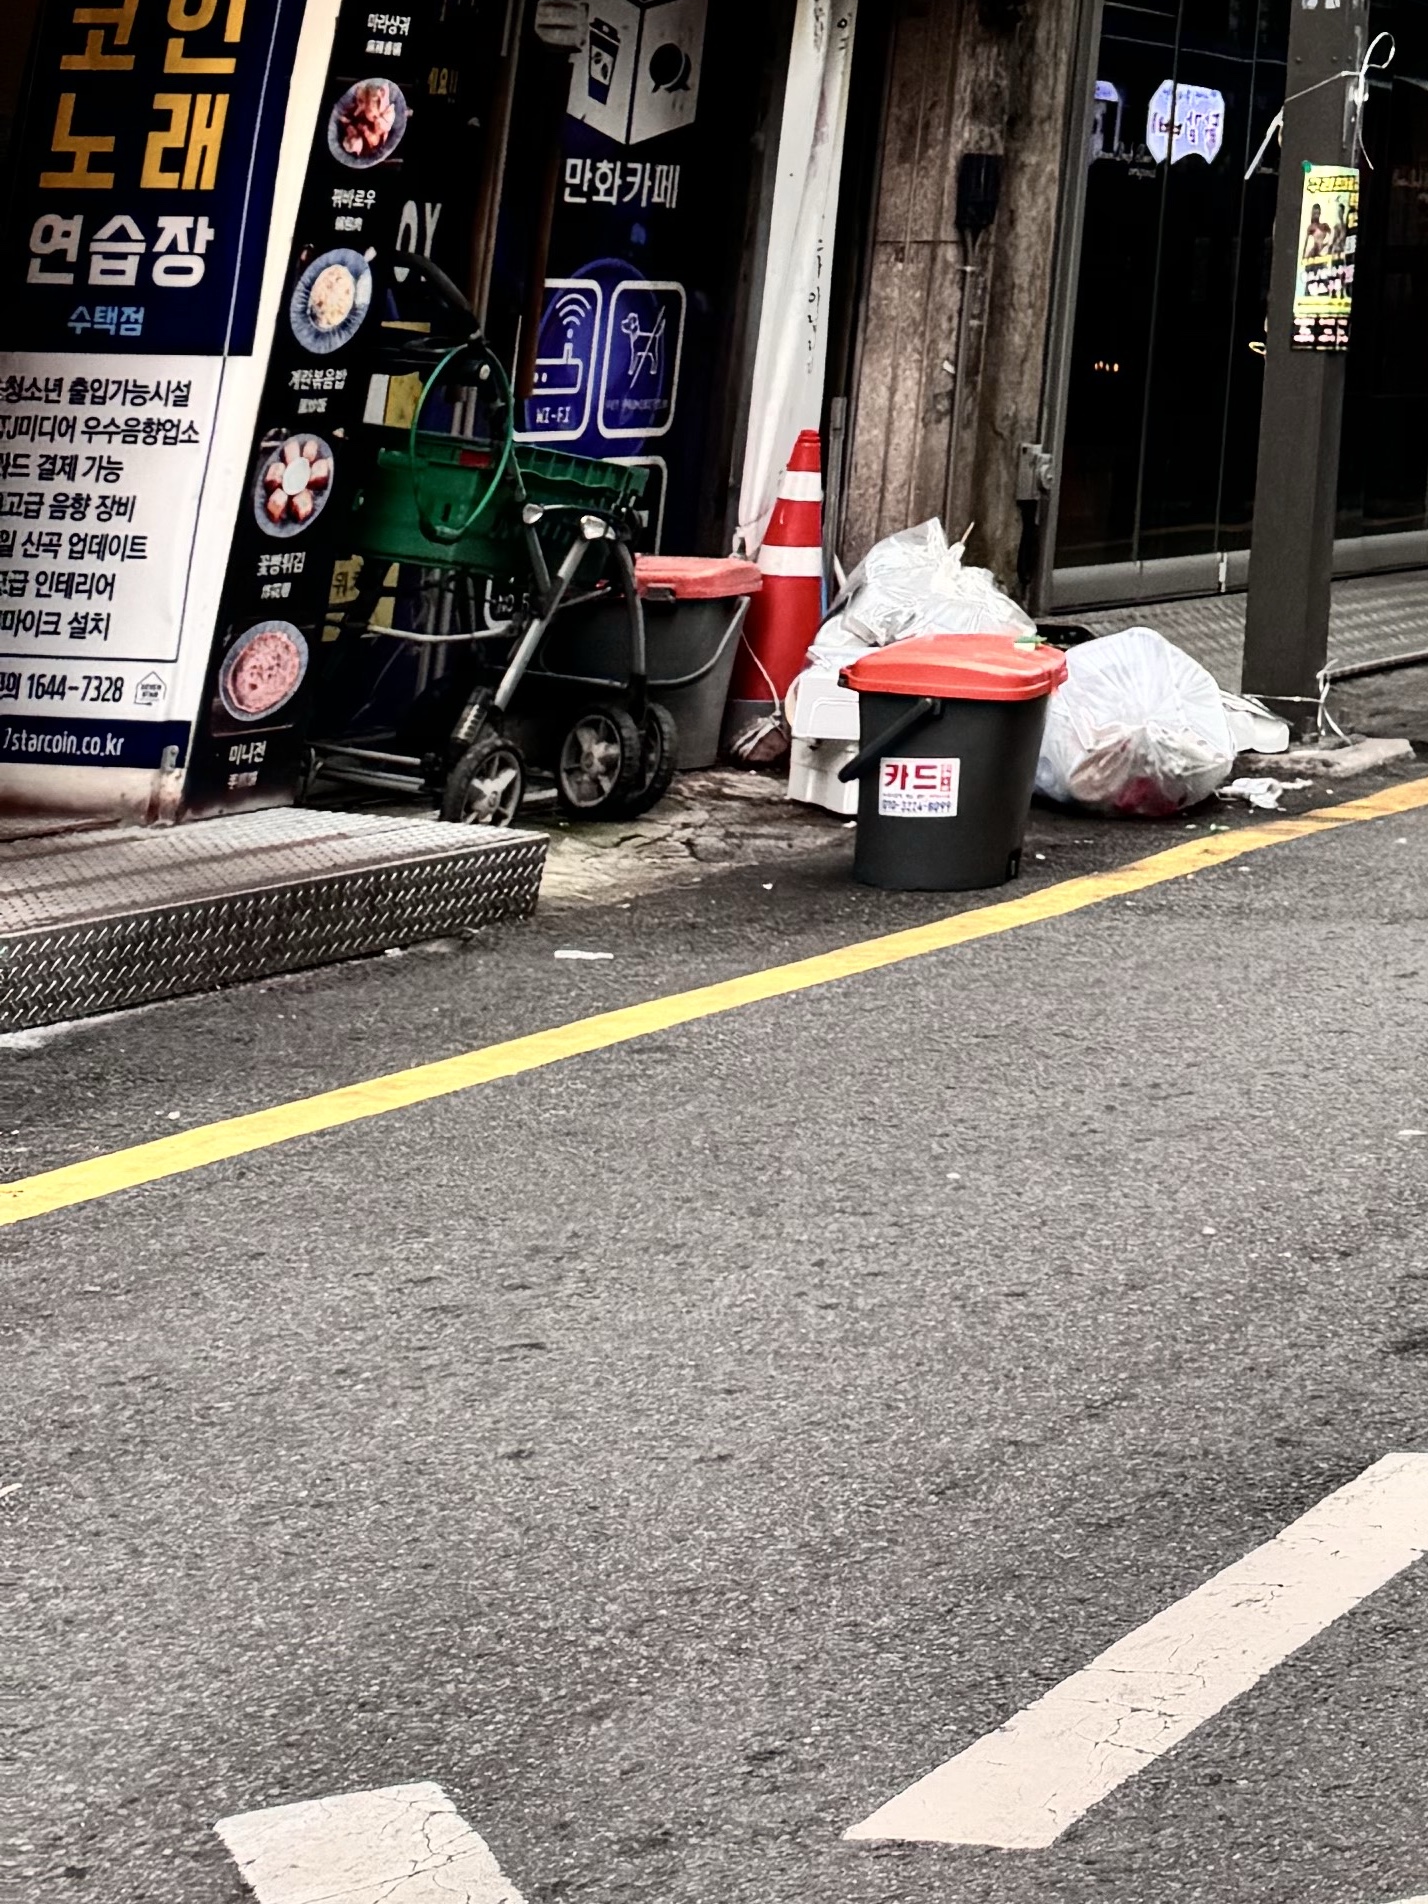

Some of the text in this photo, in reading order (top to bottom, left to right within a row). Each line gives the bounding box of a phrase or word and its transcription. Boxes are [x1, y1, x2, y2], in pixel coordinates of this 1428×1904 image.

[39, 91, 231, 191] 노래
[563, 157, 681, 209] 만화카페
[25, 212, 216, 288] 연습장
[66, 305, 146, 338] 수택점
[68, 378, 193, 409] 출입가능시설
[79, 417, 201, 447] 우수음향업소
[36, 453, 78, 483] 결제
[82, 456, 125, 483] 가능
[48, 493, 95, 522] 음향
[99, 493, 137, 524] 장비
[21, 531, 63, 561] 신곡
[68, 532, 148, 562] 업데이트
[35, 570, 116, 601] 인테리어
[67, 610, 112, 641] 설치
[26, 674, 124, 703] 1644-7328
[228, 740, 268, 766] 미니전
[883, 763, 938, 790] 카드
